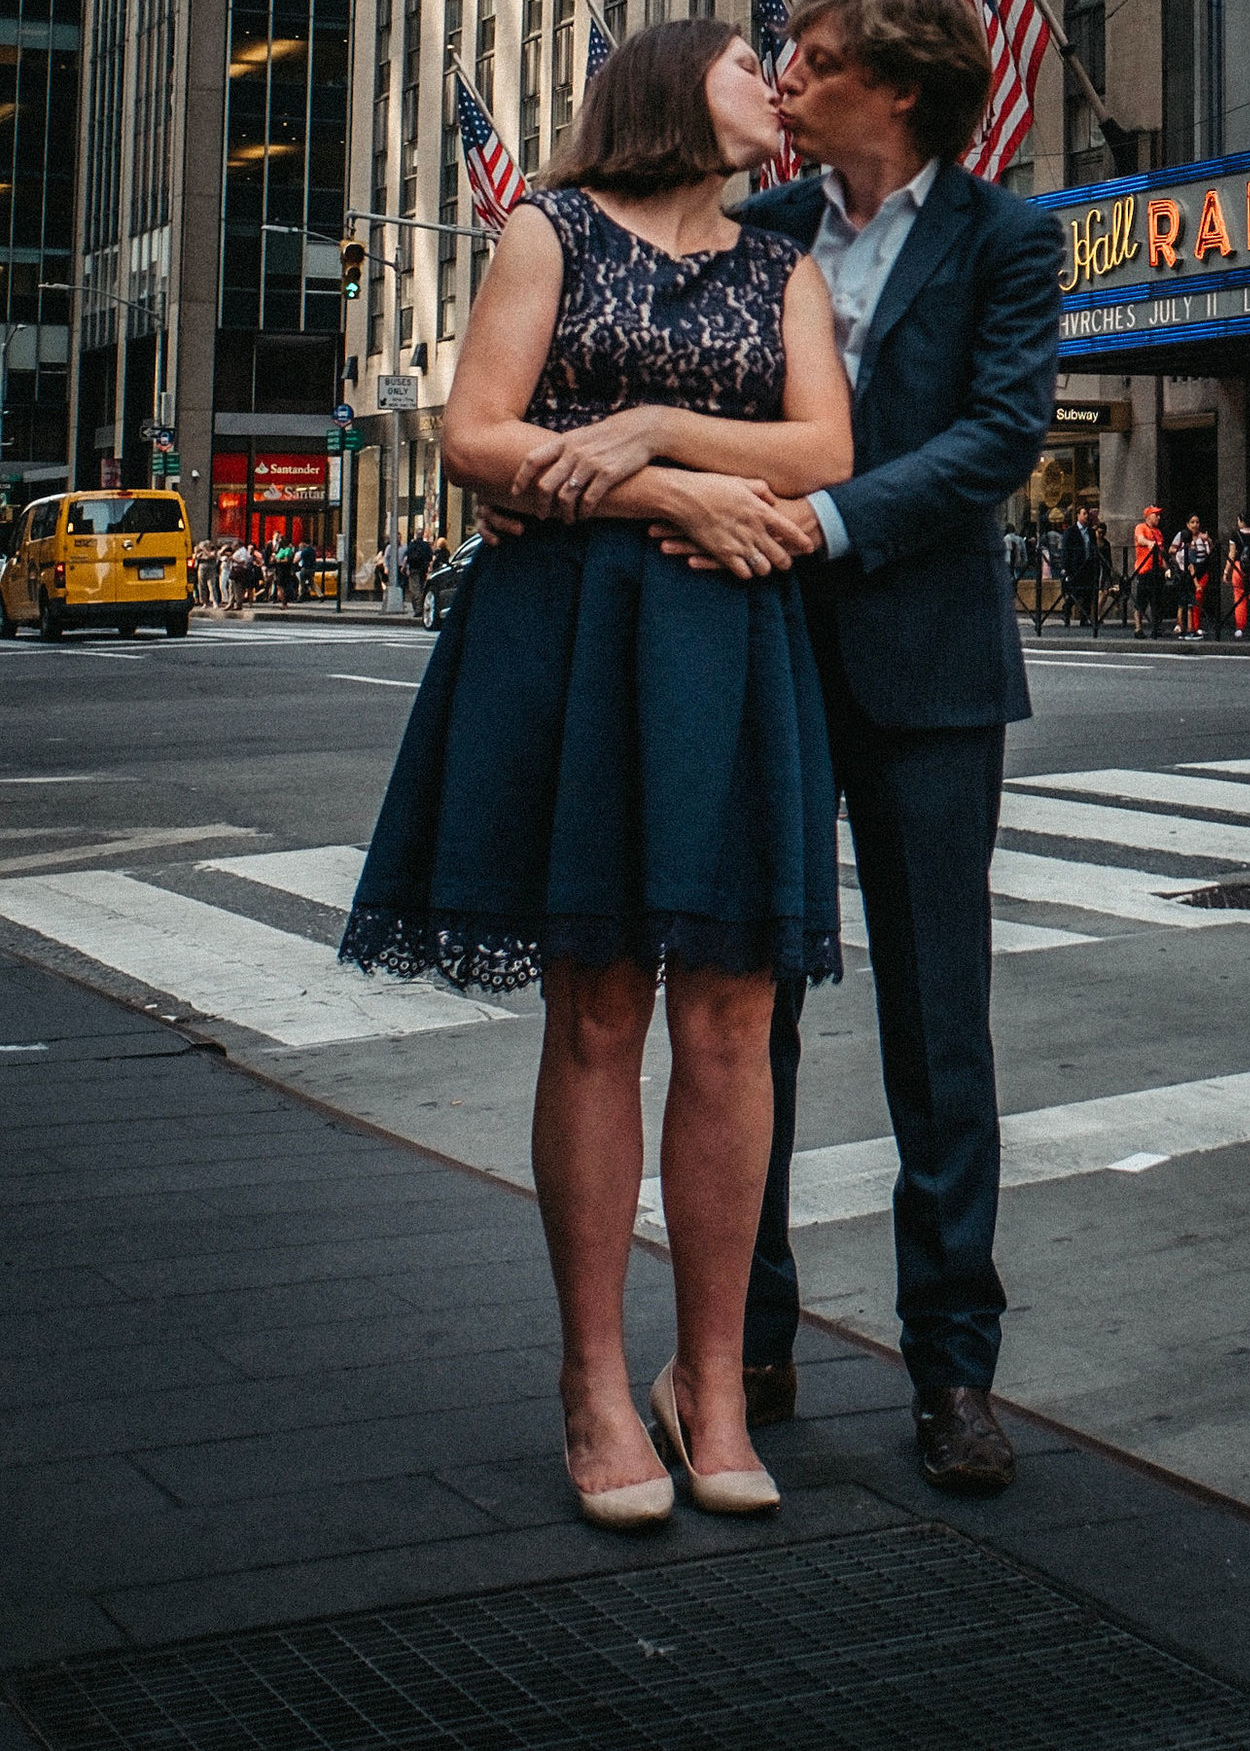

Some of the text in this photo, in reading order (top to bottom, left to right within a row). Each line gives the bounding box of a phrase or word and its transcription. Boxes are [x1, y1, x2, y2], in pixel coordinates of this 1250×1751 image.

[1058, 195, 1138, 291] Hall
[1149, 296, 1193, 325] JULY
[384, 377, 412, 387] BUSES
[387, 387, 409, 396] ONLY
[1056, 408, 1099, 423] Subway
[270, 463, 320, 475] Santander
